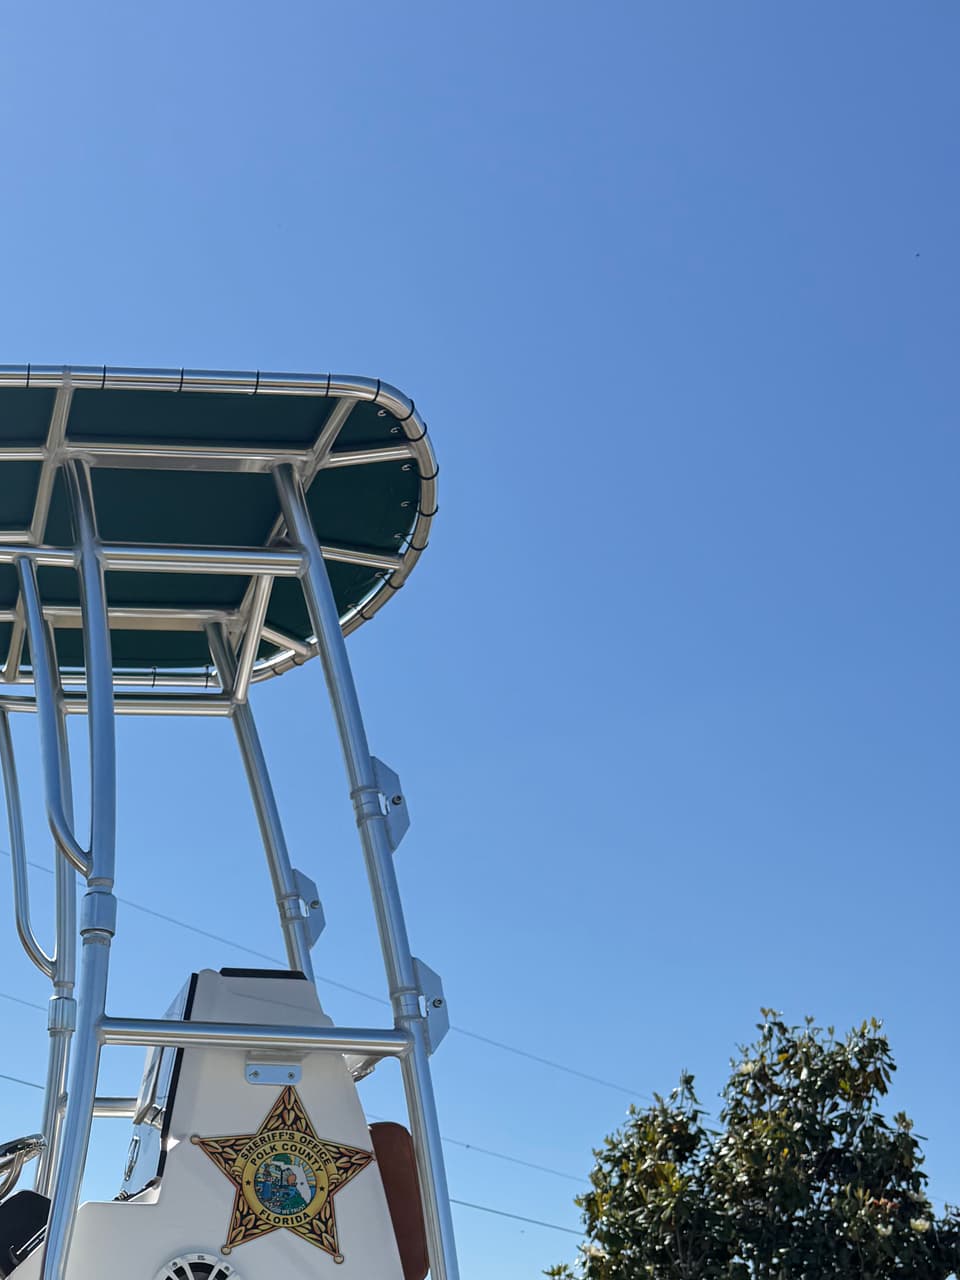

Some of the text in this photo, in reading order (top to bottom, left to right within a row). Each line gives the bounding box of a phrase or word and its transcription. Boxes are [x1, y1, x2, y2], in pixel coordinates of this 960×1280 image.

[241, 1132, 332, 1165] SHERIFF'S OFFICE
[250, 1143, 323, 1172] POLK COUNTY
[259, 1209, 311, 1225] FLORIDA
